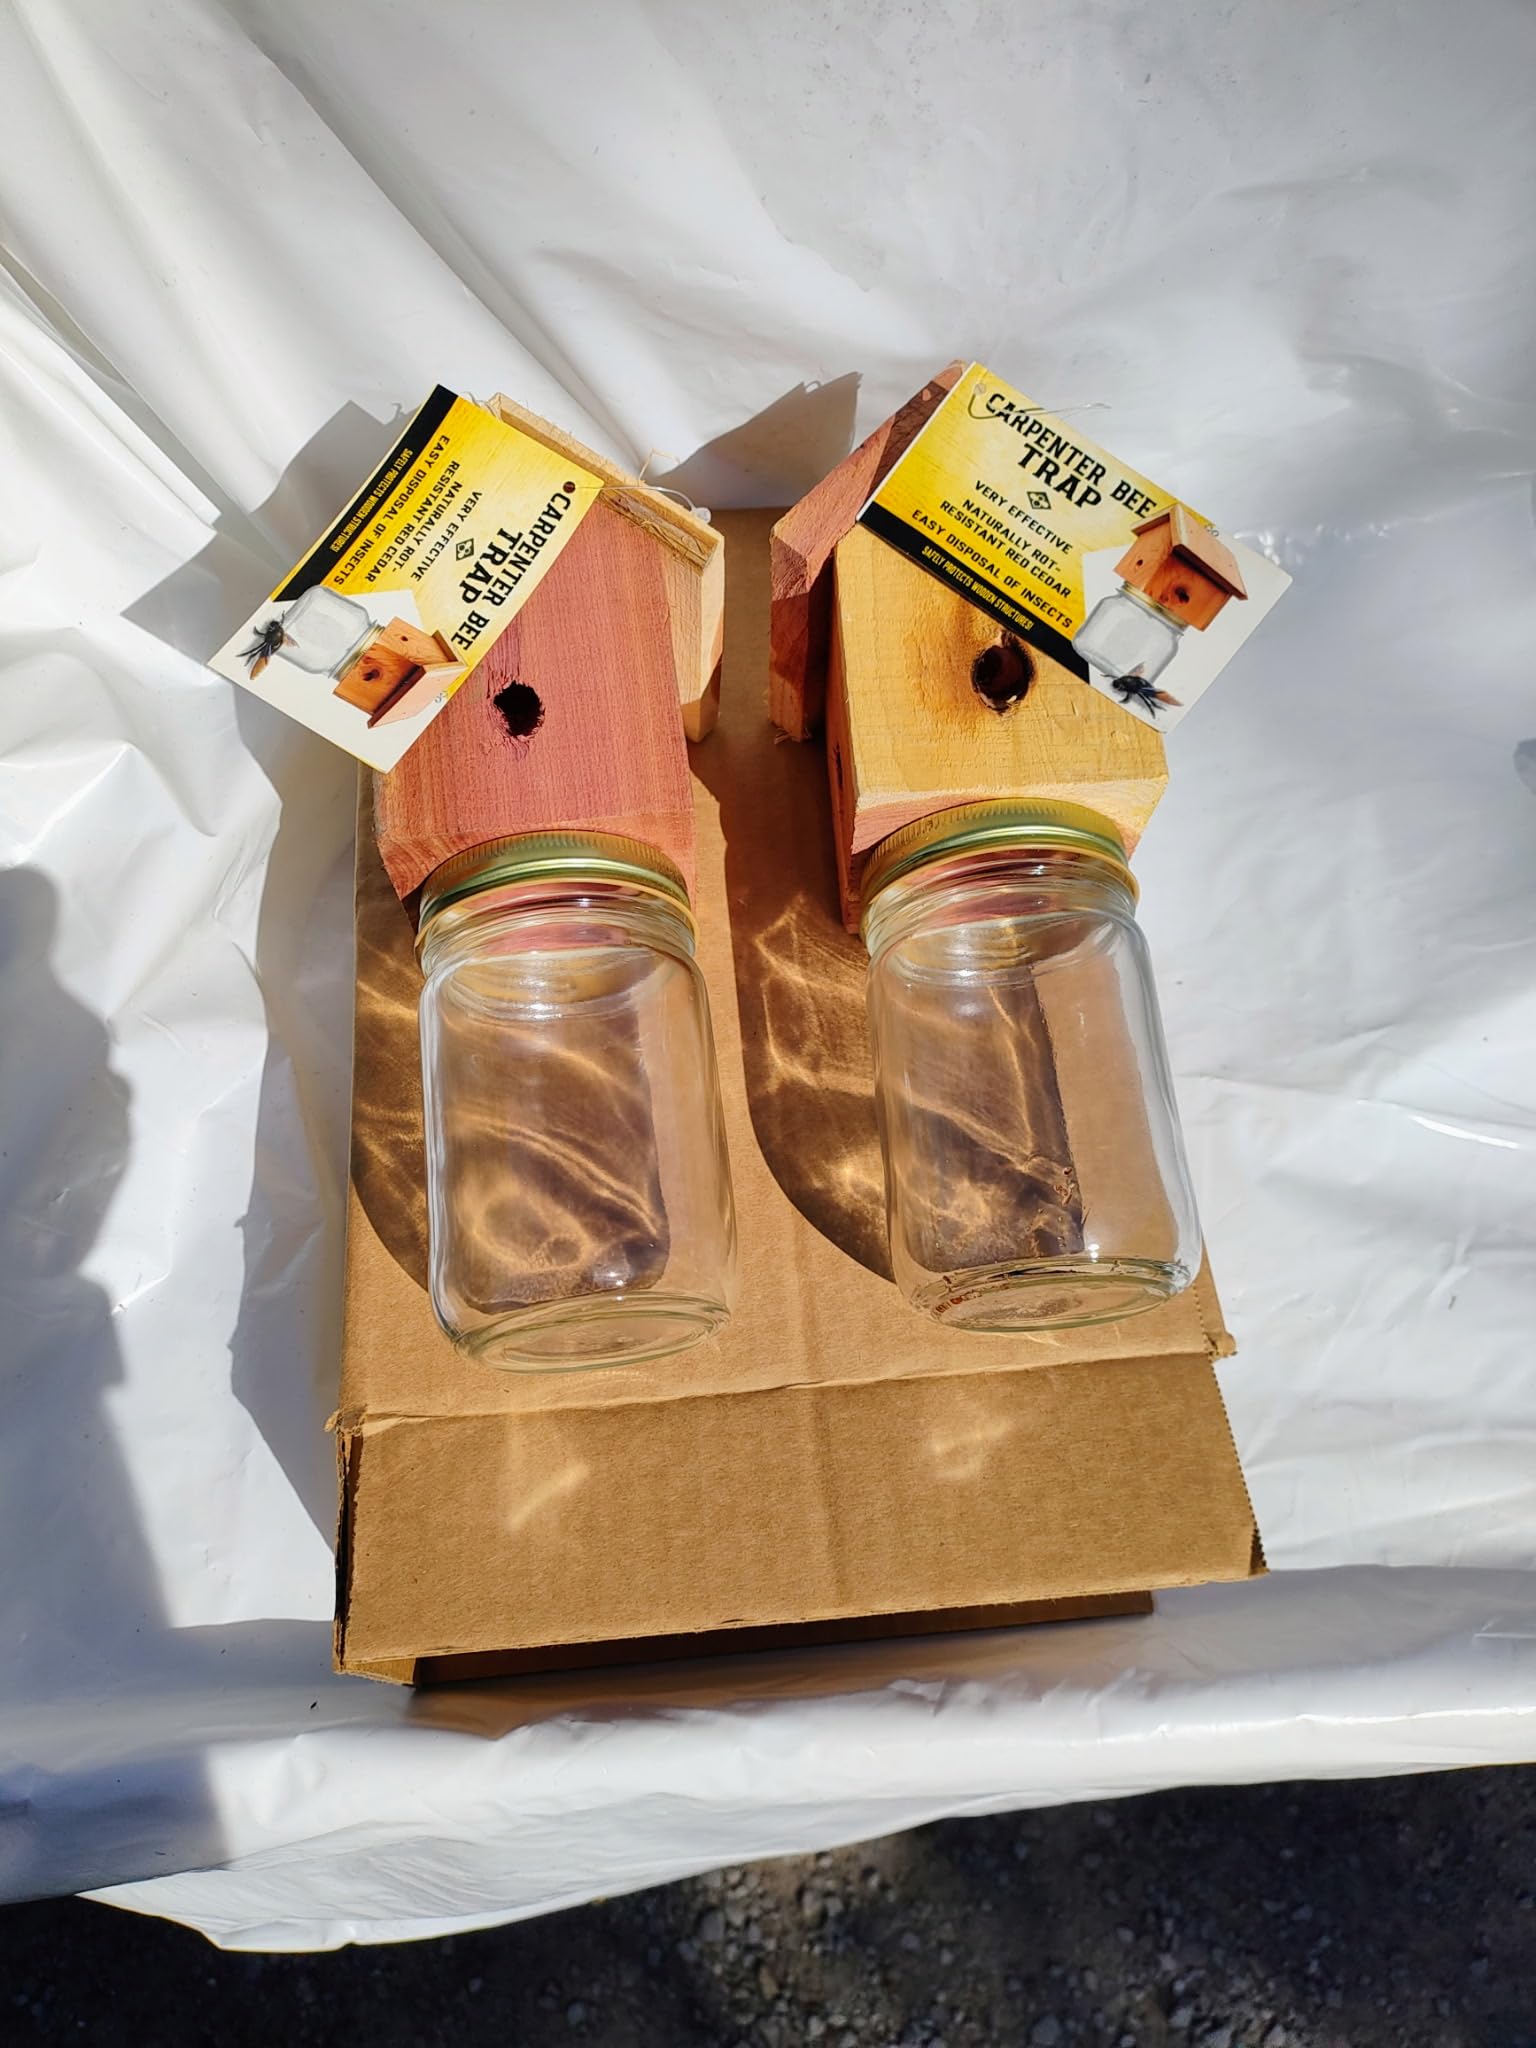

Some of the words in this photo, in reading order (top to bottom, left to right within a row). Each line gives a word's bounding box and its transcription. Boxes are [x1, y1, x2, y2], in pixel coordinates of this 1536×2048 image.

[394, 448, 413, 471] SAFELY
[425, 435, 450, 468] EASY
[986, 393, 1106, 486] CARPENTER
[1110, 480, 1157, 519] BEE
[1018, 443, 1102, 508] TRAP
[383, 469, 427, 520] DISPOSAL
[413, 461, 460, 523] RESISTANT
[413, 482, 463, 545] NATURALLY
[457, 491, 482, 522] VERY
[976, 480, 1008, 507] VERY
[1008, 505, 1073, 554] EFFECTIVE
[373, 523, 386, 539] OF
[392, 546, 415, 572] ROT-
[394, 523, 415, 544] RED
[411, 522, 459, 581] EFFECTIVE
[483, 493, 571, 606] CARPENTER
[940, 501, 1005, 550] RESISTANT
[1005, 548, 1029, 569] RED
[1030, 566, 1071, 598] CEDAR
[963, 500, 1032, 550] NATURALLY
[1032, 549, 1061, 572] ROT-
[334, 539, 374, 585] INSECTS
[365, 546, 397, 582] CEDAR
[459, 527, 523, 604] TRAP
[912, 509, 946, 535] EASY
[946, 534, 1000, 579] DISPOSAL
[1003, 576, 1021, 589] OF
[1021, 588, 1073, 628] INSECTS
[921, 546, 945, 566] SAFELY
[943, 560, 973, 587] PROTECTS
[971, 581, 997, 604] WOODEN
[451, 611, 490, 651] BEE
